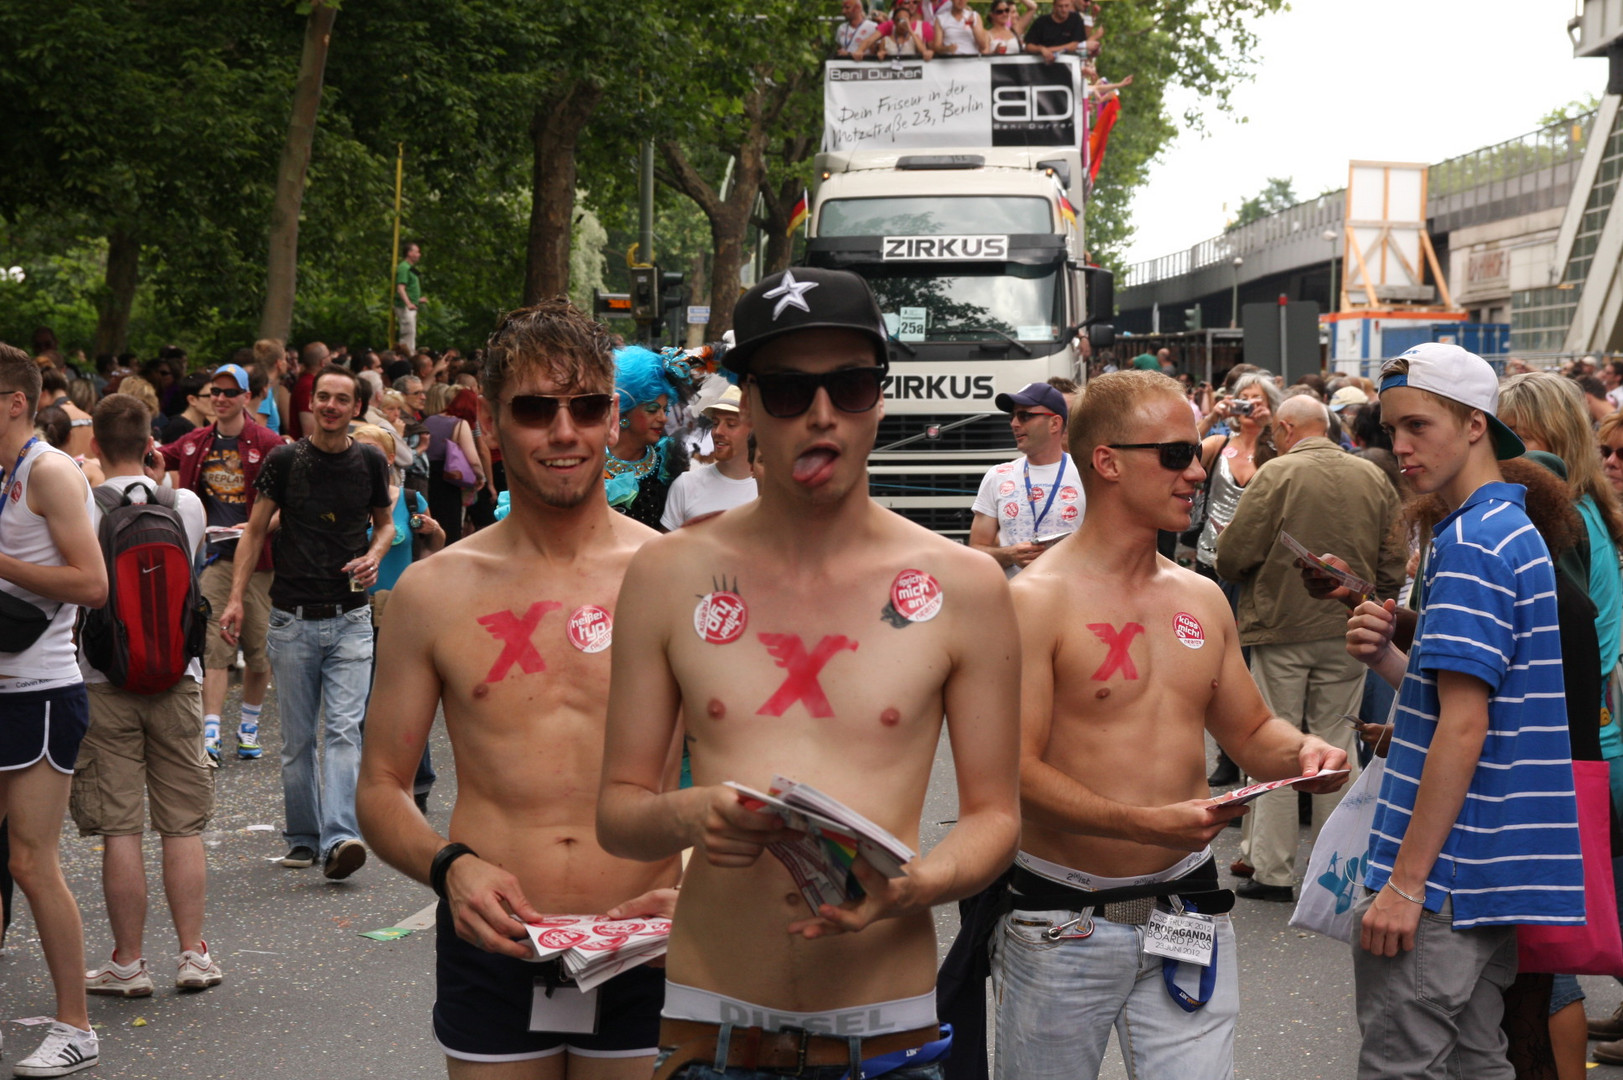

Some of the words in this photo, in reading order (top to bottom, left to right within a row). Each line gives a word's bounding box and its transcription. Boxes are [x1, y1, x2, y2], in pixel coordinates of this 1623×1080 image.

[829, 69, 862, 80] Beni
[868, 68, 922, 80] Durrer
[838, 105, 872, 124] Dein
[877, 95, 923, 114] Friseur
[928, 90, 941, 102] in
[945, 80, 968, 98] der
[832, 113, 908, 149] Motzstraße
[912, 109, 936, 127] 23,
[941, 95, 984, 123] Berlin
[885, 238, 1005, 257] ZIRKUS
[901, 321, 924, 335] 25a
[881, 375, 994, 400] ZIRKUS
[898, 582, 930, 600] mich
[707, 600, 732, 632] typ
[1179, 615, 1199, 629] küss
[579, 622, 606, 642] typ
[1177, 625, 1200, 639] mich!
[16, 680, 38, 689] Calvin
[1149, 921, 1212, 943] PROPAGANDA
[1195, 922, 1212, 933] 2012
[1147, 930, 1185, 945] BOARD
[1187, 938, 1212, 951] PASS
[1183, 947, 1201, 957] 2012
[719, 1000, 895, 1036] DIESEL
